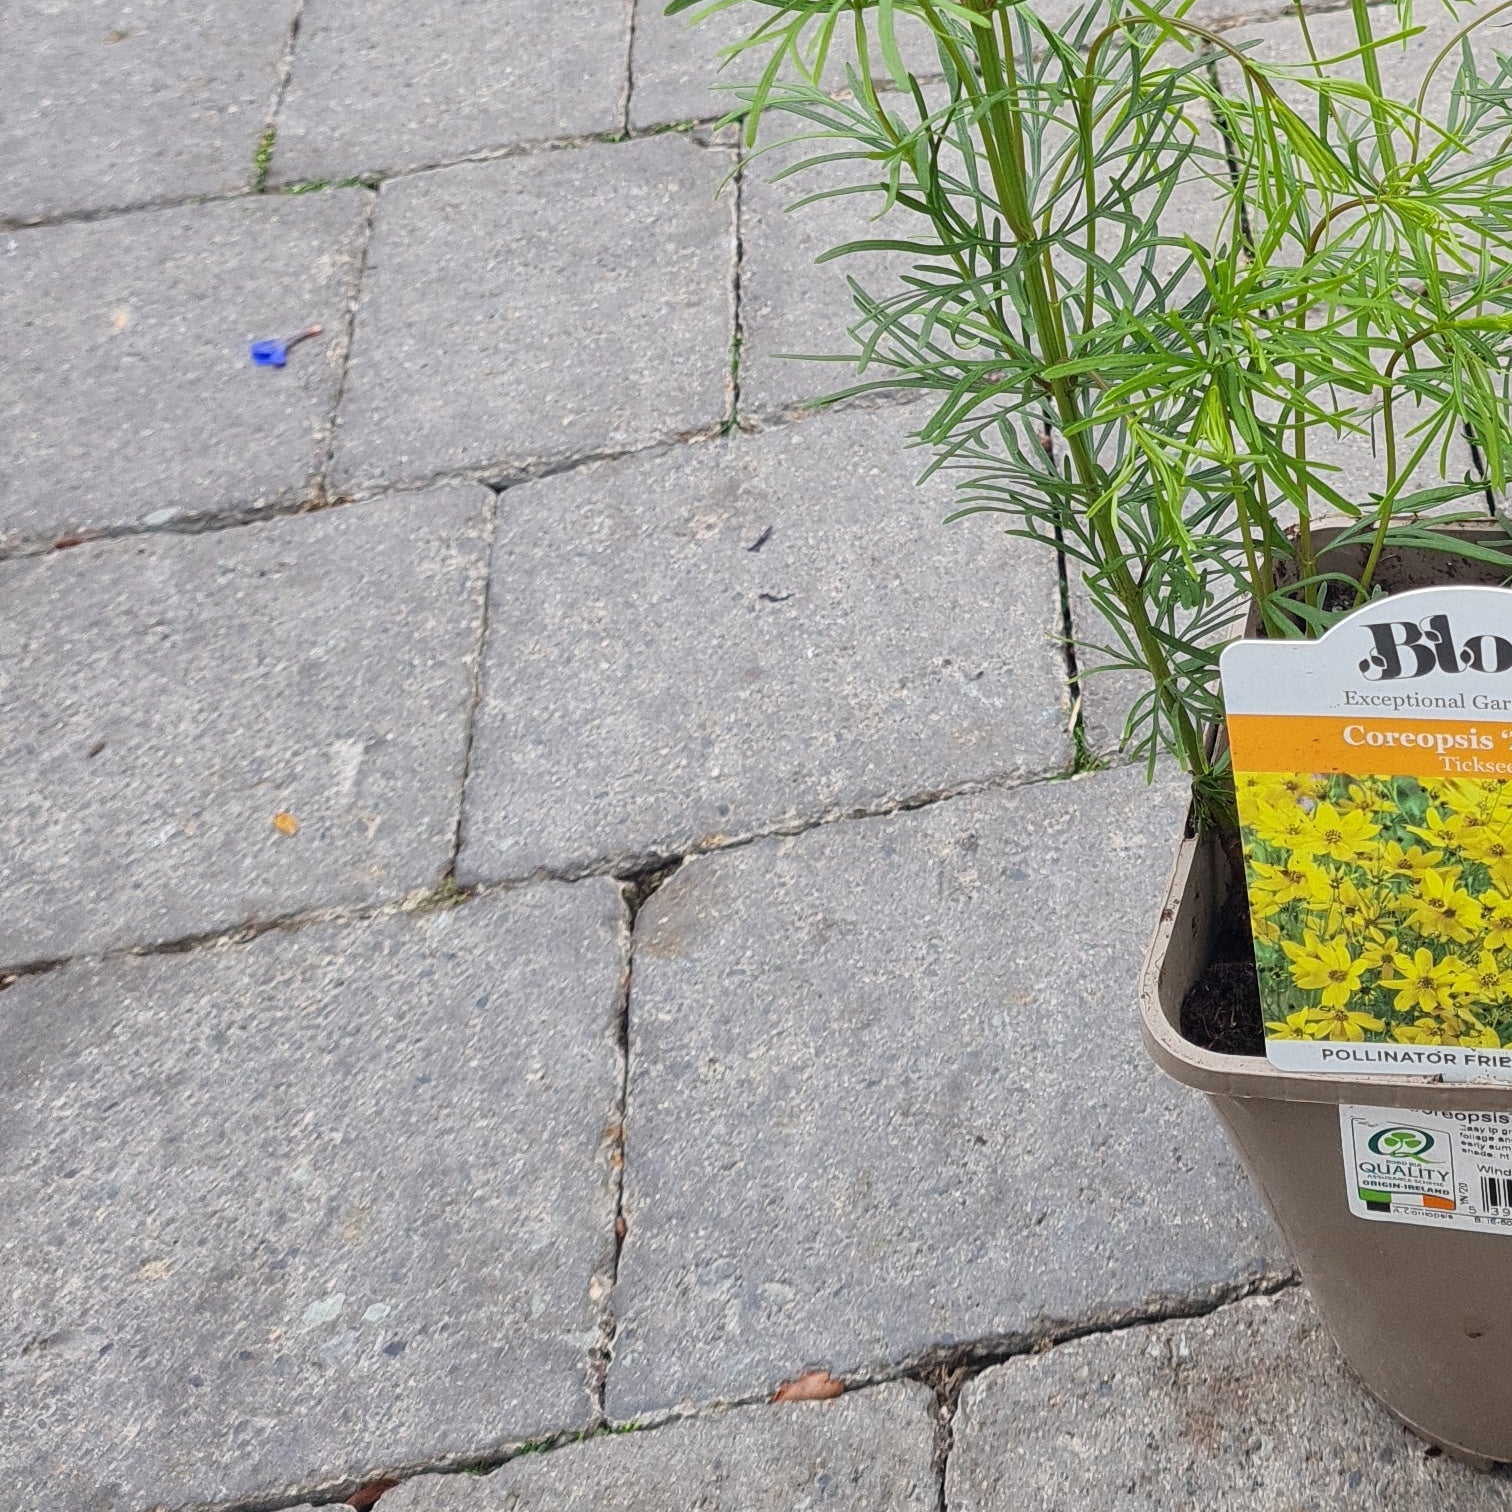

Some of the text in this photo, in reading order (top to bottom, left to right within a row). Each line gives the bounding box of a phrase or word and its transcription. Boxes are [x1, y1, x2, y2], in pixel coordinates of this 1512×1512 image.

[1343, 690, 1466, 710] Exceptional
[1342, 725, 1494, 757] Coreopsis
[1322, 1048, 1457, 1066] POLLINATOR
[1359, 1161, 1450, 1183] QUALITY
[1468, 1205, 1478, 1215] 5
